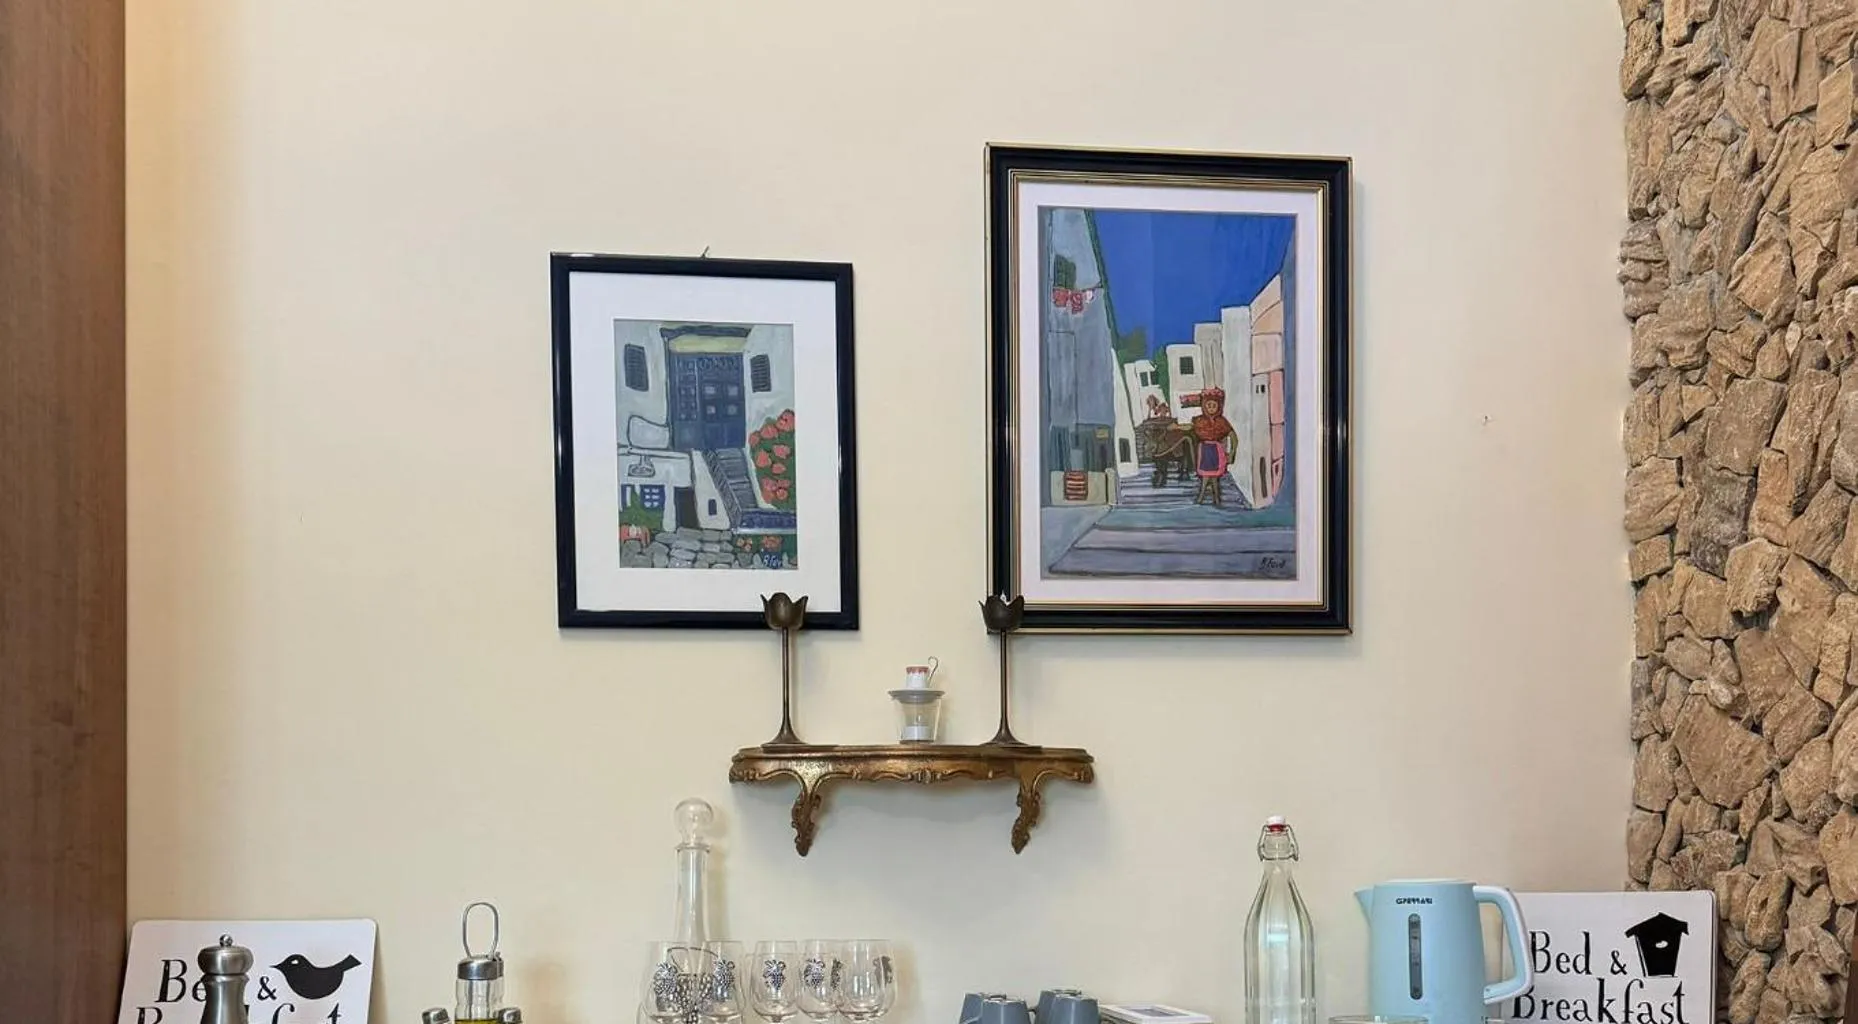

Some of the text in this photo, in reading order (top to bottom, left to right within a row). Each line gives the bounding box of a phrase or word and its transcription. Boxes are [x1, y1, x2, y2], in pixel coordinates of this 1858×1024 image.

[1529, 931, 1628, 975] Bed &
[154, 958, 278, 1003] Be &
